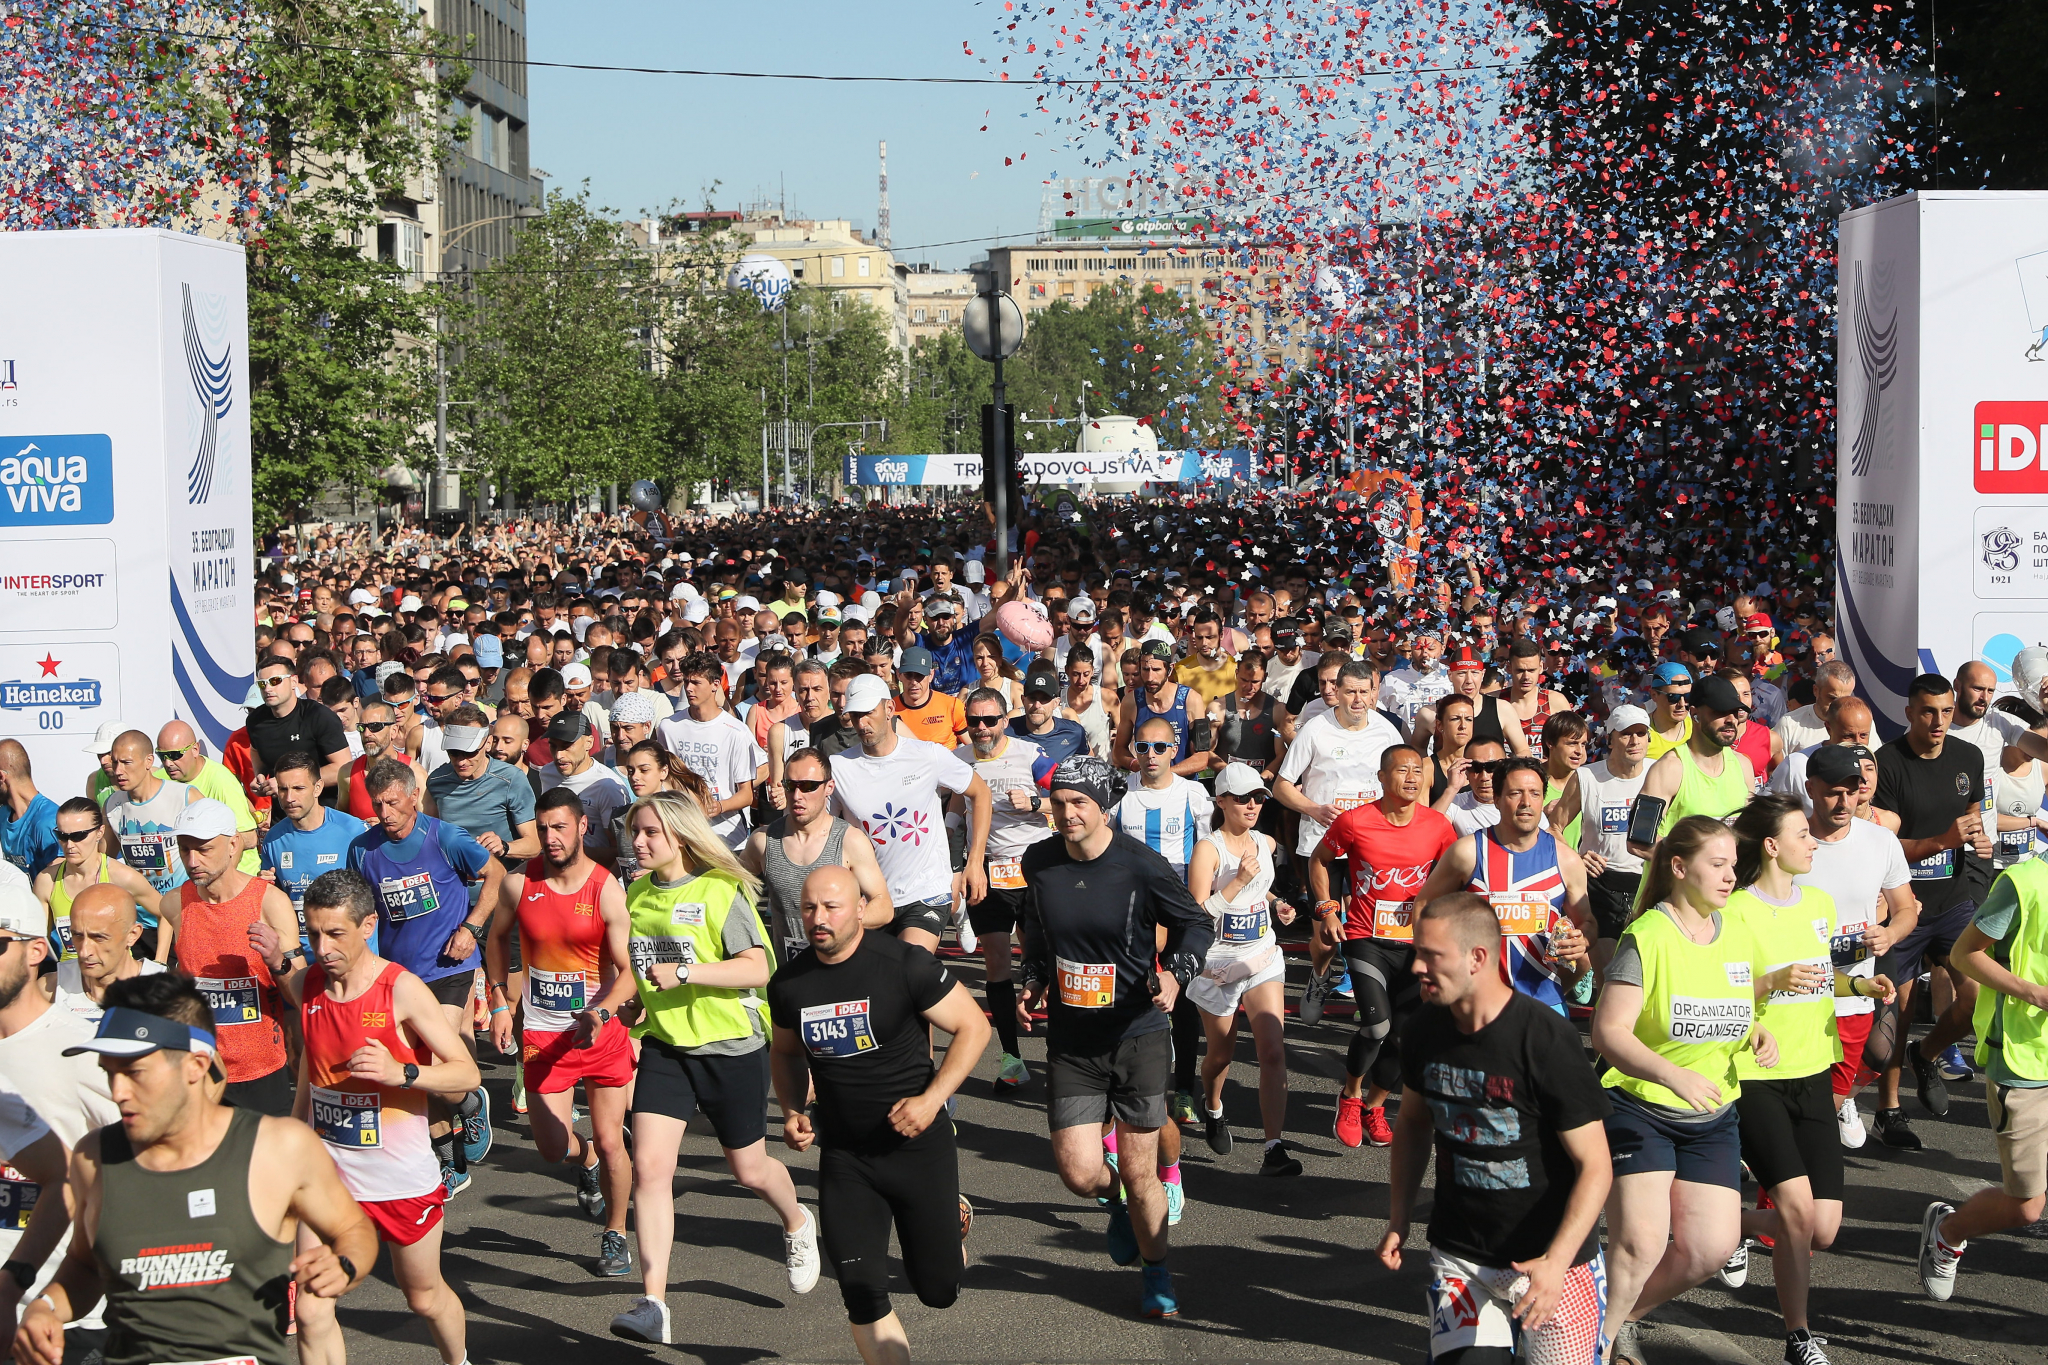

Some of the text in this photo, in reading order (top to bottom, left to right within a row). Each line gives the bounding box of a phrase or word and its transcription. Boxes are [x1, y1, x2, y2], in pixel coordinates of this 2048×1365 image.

[1980, 423, 2048, 471] iD
[1, 455, 88, 485] aqua
[850, 456, 858, 485] START
[875, 461, 909, 473] aqua
[1021, 459, 1154, 475] ADOVOLJSTVA
[877, 472, 906, 483] viva
[6, 484, 82, 513] viva
[1861, 502, 1894, 530] БЕОГРАДСКИ
[201, 527, 235, 553] БЕОГРАДСКИ
[1852, 531, 1894, 567] МАРАТОН
[4, 574, 104, 590] INTERSPORT
[193, 556, 236, 593] МАРАТОН
[1991, 576, 2011, 584] 1921
[5, 684, 96, 704] Heineken
[39, 710, 63, 730] 0.0
[678, 741, 719, 755] 35.BGD
[143, 835, 162, 844] iDEA
[2003, 832, 2028, 845] 5659
[131, 845, 156, 858] 6365
[993, 865, 1021, 879] 0292
[406, 874, 427, 887] iDEA
[386, 889, 418, 908] 5822
[427, 900, 433, 909] D
[1252, 901, 1266, 912] iDEA
[1495, 904, 1530, 920] 0706
[1230, 914, 1257, 930] 3217
[1379, 911, 1410, 926] 0607
[1538, 921, 1543, 929] A
[1846, 924, 1864, 934] iDEA
[629, 941, 691, 954] ORGANIZATOR
[558, 973, 581, 982] iDEA
[1086, 966, 1111, 975] iDEA
[228, 979, 252, 990] iDEA
[539, 981, 573, 998] 5940
[1064, 973, 1101, 992] 0956
[574, 999, 580, 1007] D
[1101, 995, 1107, 1003] A
[246, 1009, 253, 1019] A
[839, 1002, 864, 1014] iDEA
[1673, 1002, 1751, 1018] ORGANIZATOR
[810, 1018, 848, 1043] 3143
[1672, 1022, 1749, 1039] ORGANISER
[860, 1038, 868, 1048] A
[345, 1095, 373, 1106] iDEA
[315, 1102, 354, 1129] 5092
[365, 1132, 372, 1142] A
[138, 1242, 214, 1257] AMSTERDAM
[120, 1249, 228, 1274] RUNNING
[138, 1263, 235, 1291] JUNKIES
